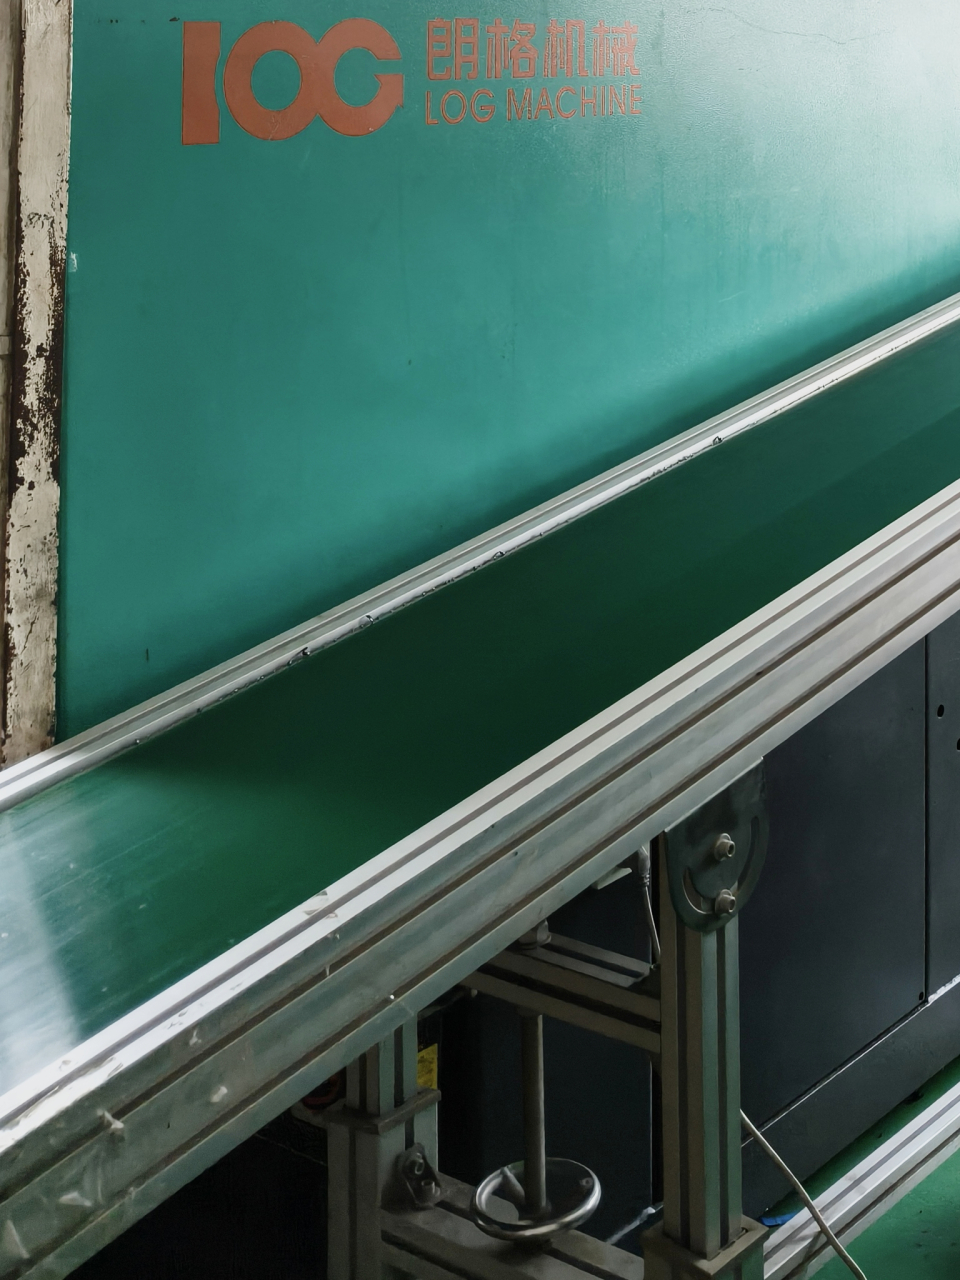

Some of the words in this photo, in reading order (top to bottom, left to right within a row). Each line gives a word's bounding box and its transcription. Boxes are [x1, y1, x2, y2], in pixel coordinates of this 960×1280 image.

[426, 17, 641, 81] 朗格机械
[425, 88, 496, 126] LOG
[506, 84, 643, 121] MACHINE
